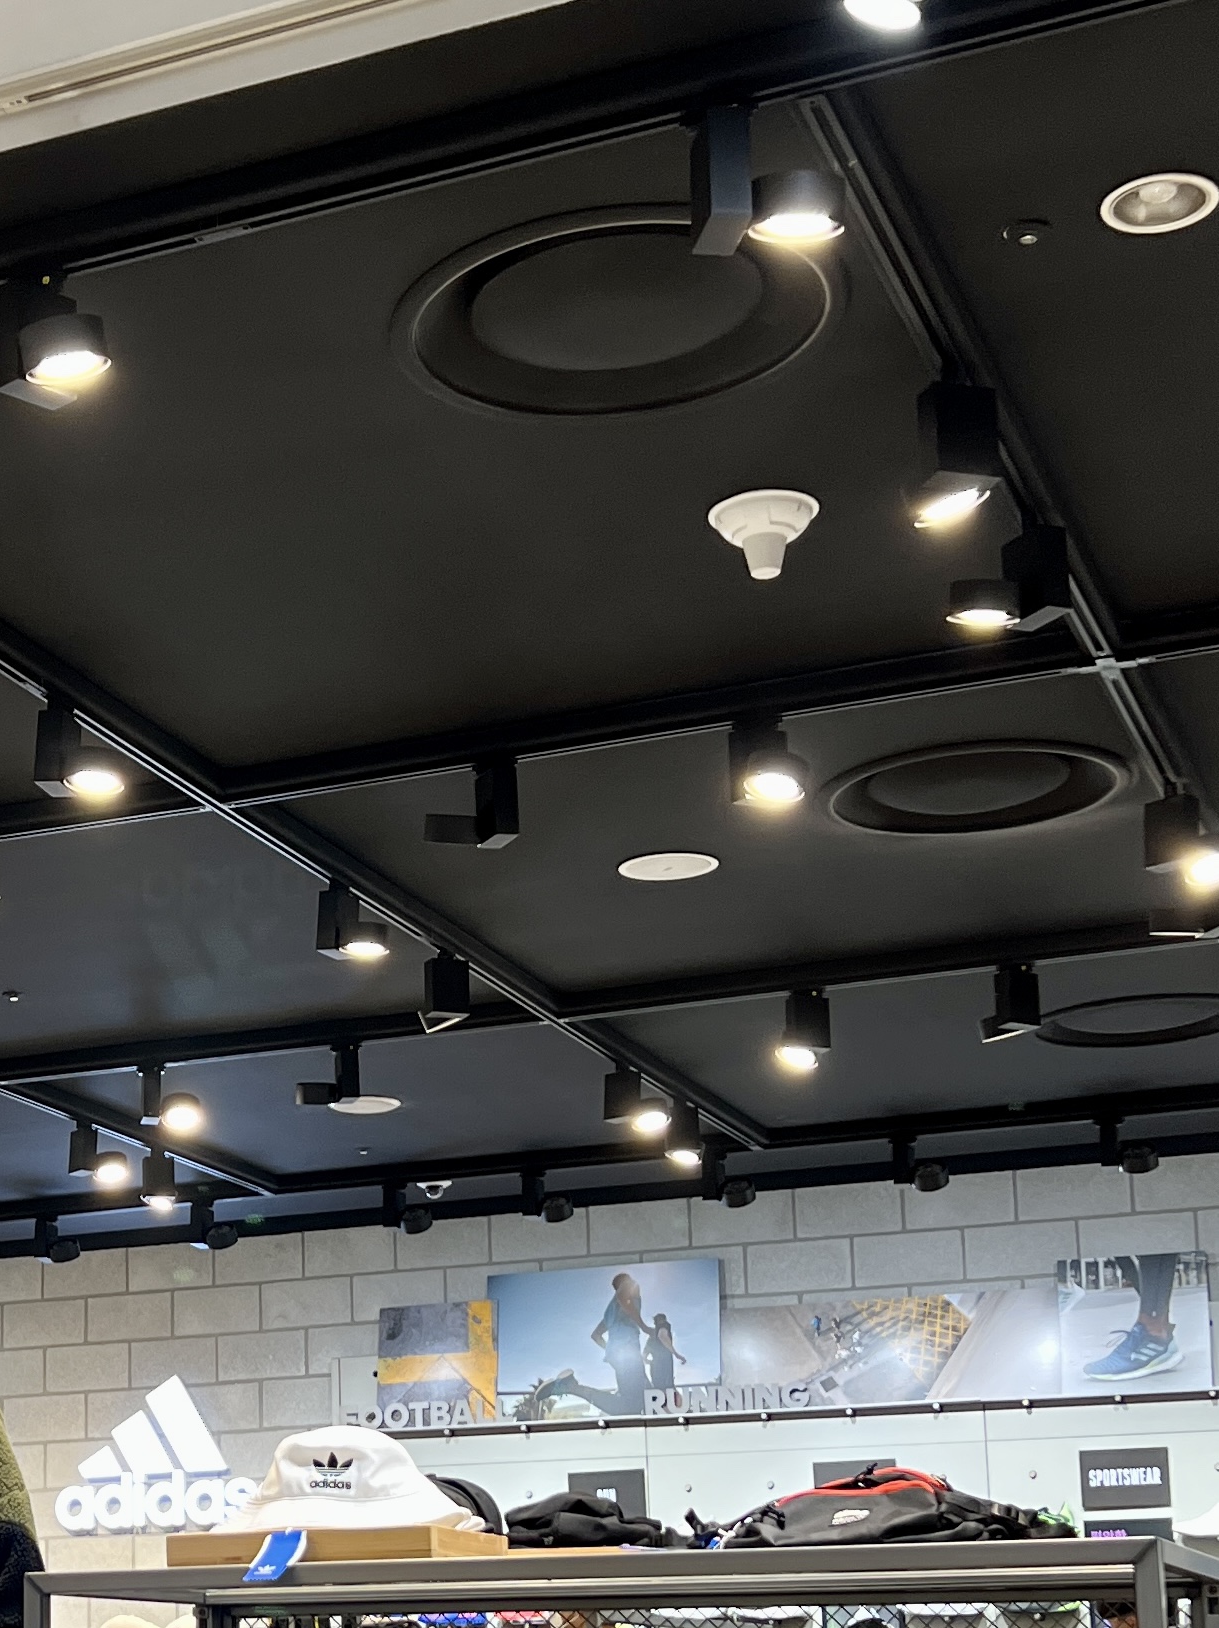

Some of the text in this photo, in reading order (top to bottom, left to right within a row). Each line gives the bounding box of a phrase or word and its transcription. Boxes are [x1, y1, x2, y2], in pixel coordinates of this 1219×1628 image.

[643, 1382, 811, 1415] RUNNING
[340, 1399, 516, 1429] FOOTBALL
[309, 1479, 352, 1490] adidas
[1088, 1466, 1162, 1487] SPORTSWEAR
[54, 1469, 259, 1534] adidas
